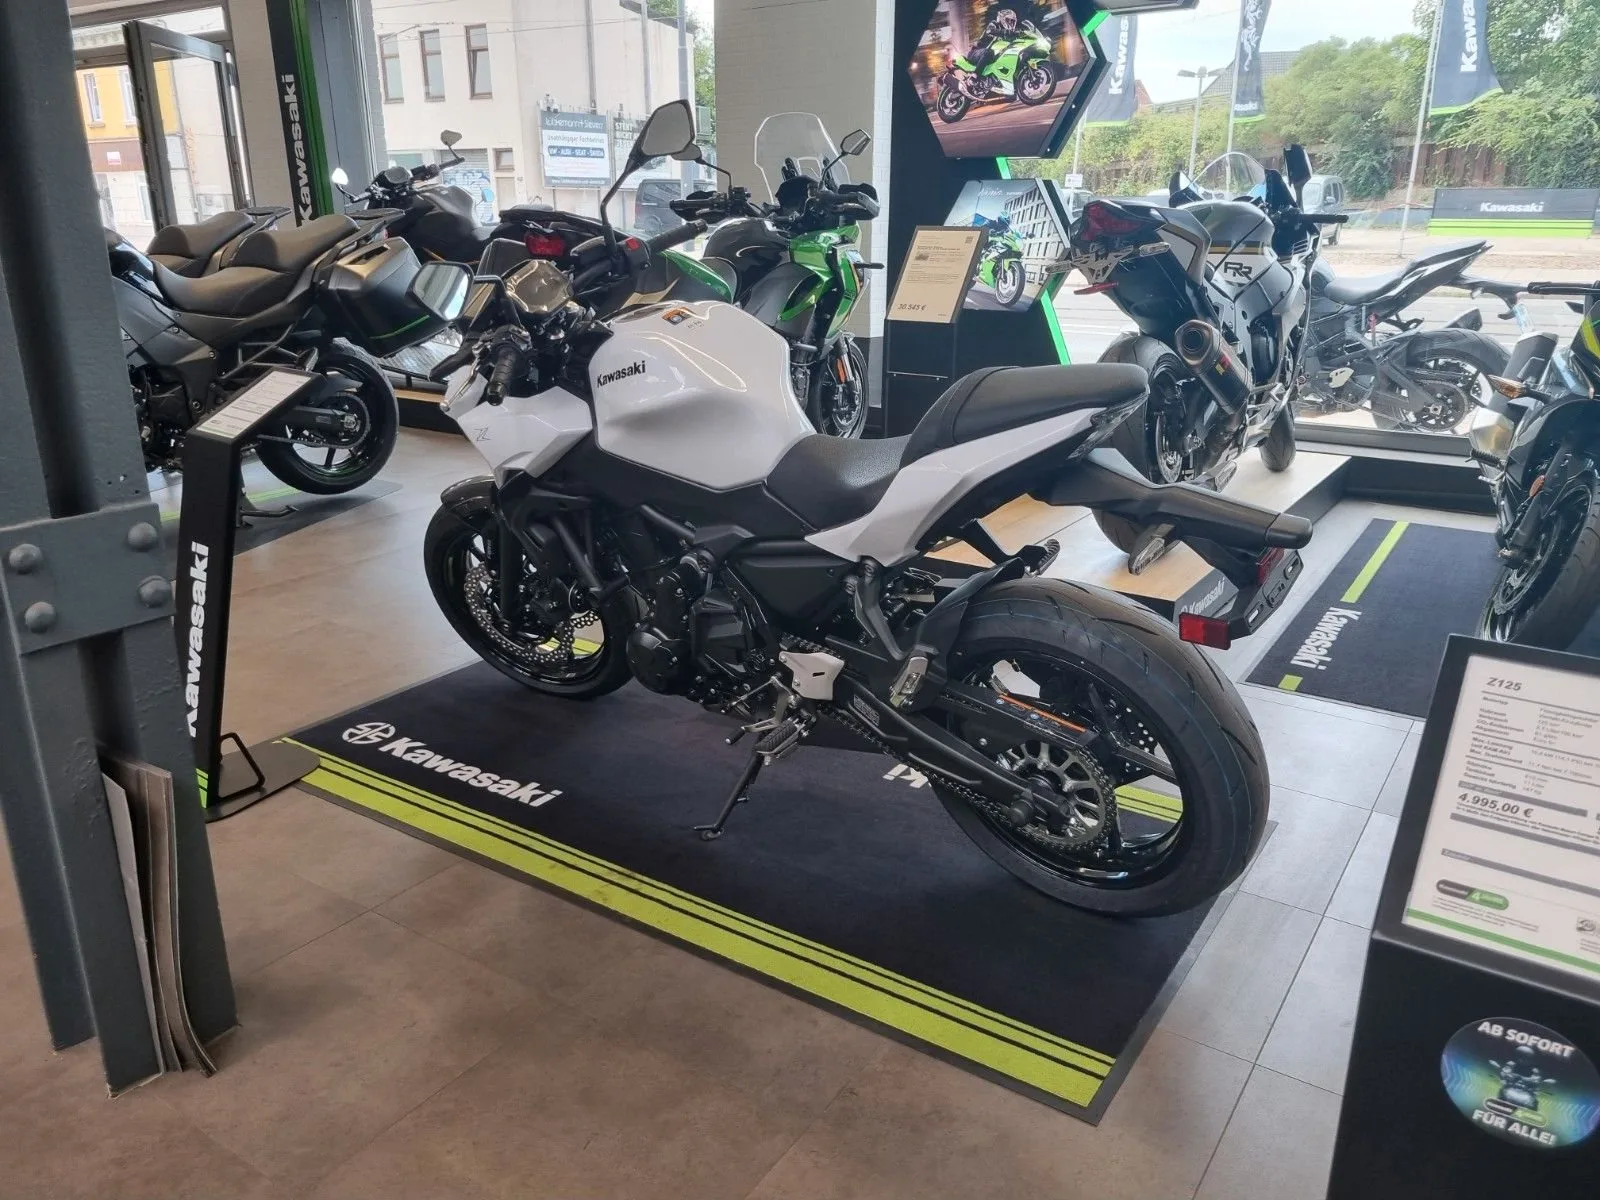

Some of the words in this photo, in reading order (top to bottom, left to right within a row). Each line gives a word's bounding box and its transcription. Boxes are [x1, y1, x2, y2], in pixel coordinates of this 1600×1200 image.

[282, 74, 313, 225] Kawasaki
[1480, 201, 1545, 213] Kawasaki
[596, 360, 646, 388] Kawasaki
[1289, 607, 1362, 670] Kawasaki
[1486, 677, 1522, 691] Z125
[378, 736, 563, 807] Kawasaki
[1458, 793, 1520, 814] 4.995,00
[1523, 808, 1534, 818] €
[1477, 1021, 1503, 1036] AB
[1505, 1029, 1576, 1058] SOFORT
[1471, 1109, 1507, 1130] FÜR
[1508, 1121, 1557, 1146] ALLE!
